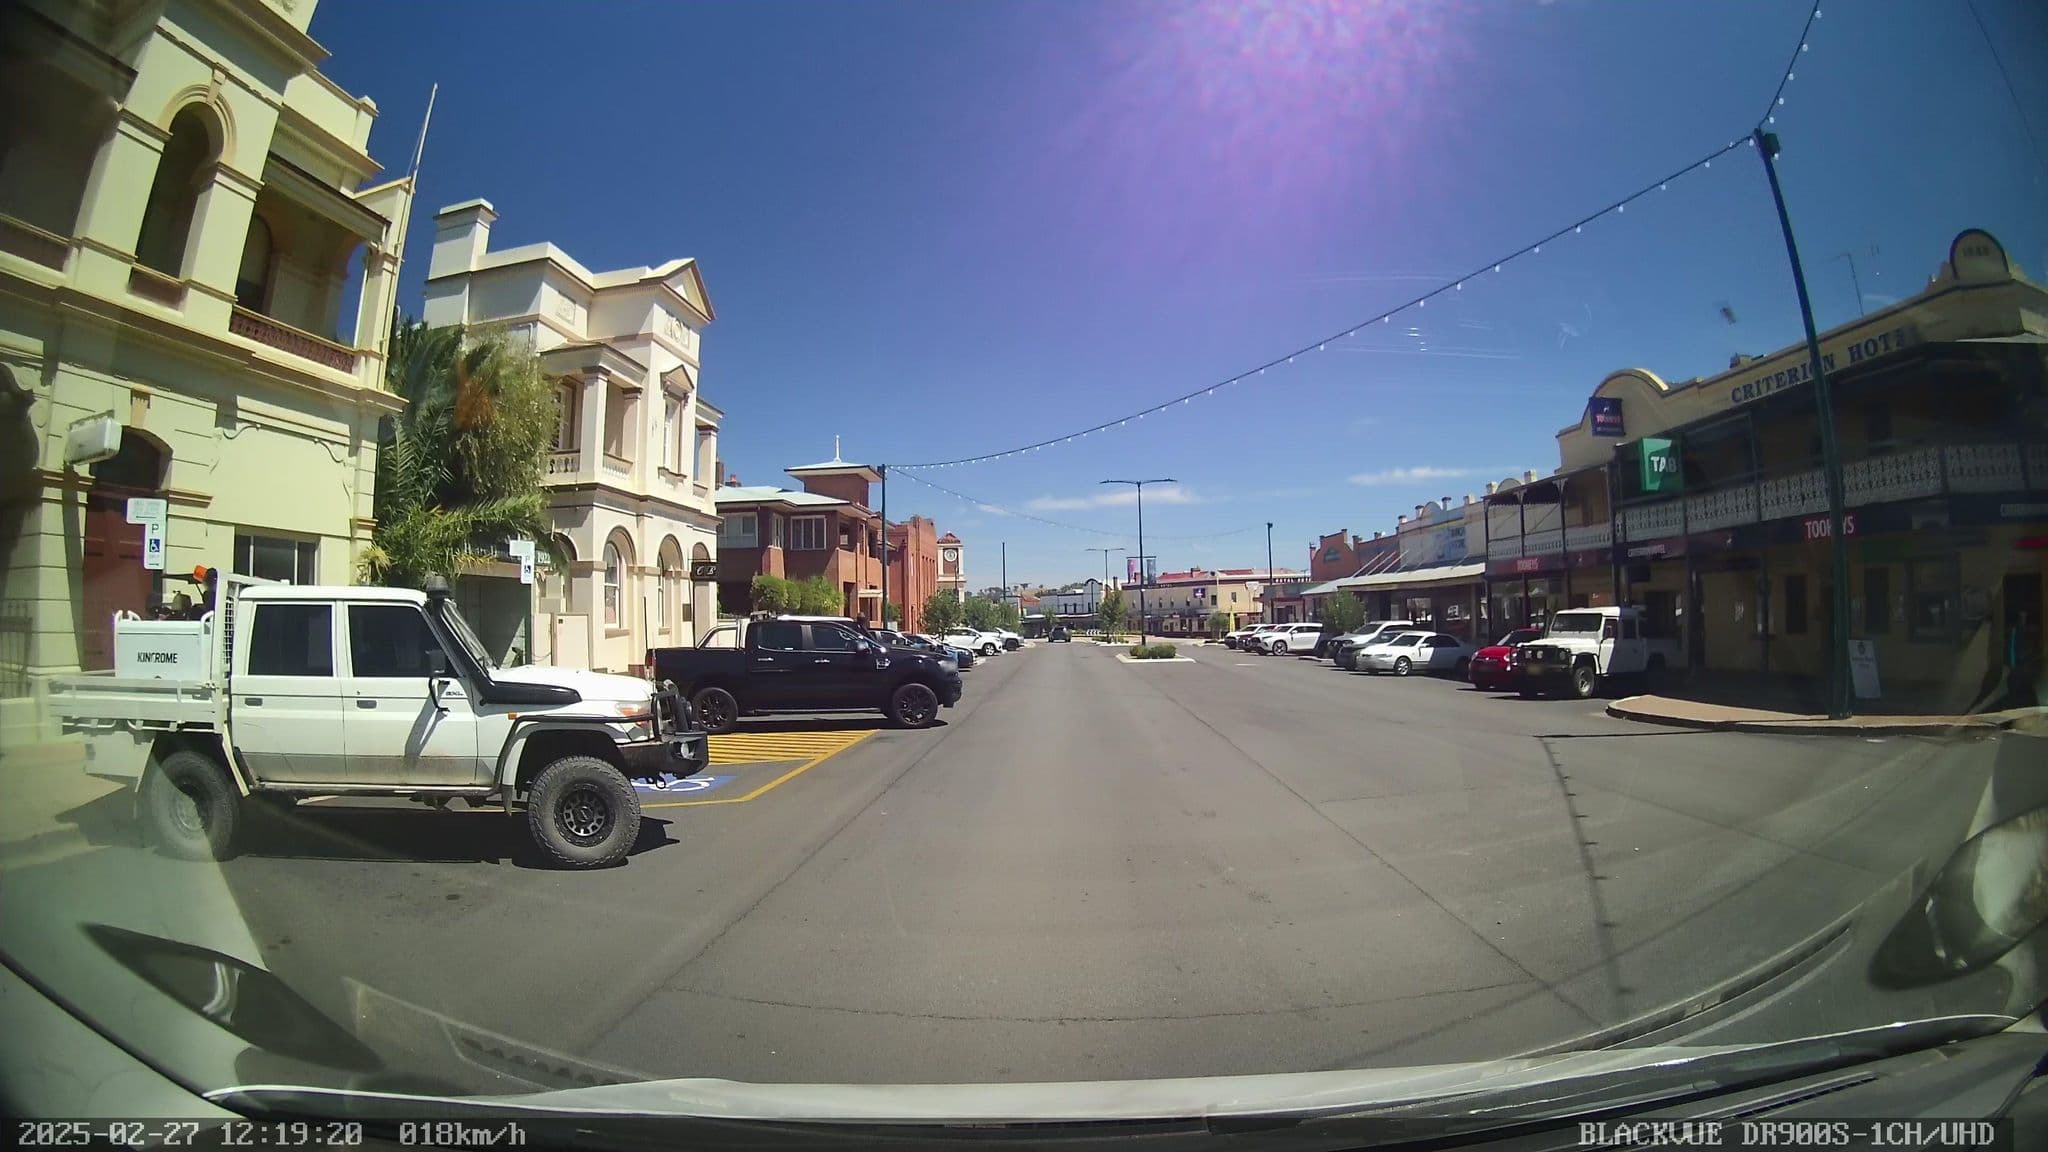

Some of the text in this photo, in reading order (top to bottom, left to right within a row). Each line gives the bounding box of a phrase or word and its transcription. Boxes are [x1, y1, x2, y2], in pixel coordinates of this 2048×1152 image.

[1848, 328, 1905, 363] HOT
[1650, 456, 1677, 473] TAB
[151, 523, 160, 534] P
